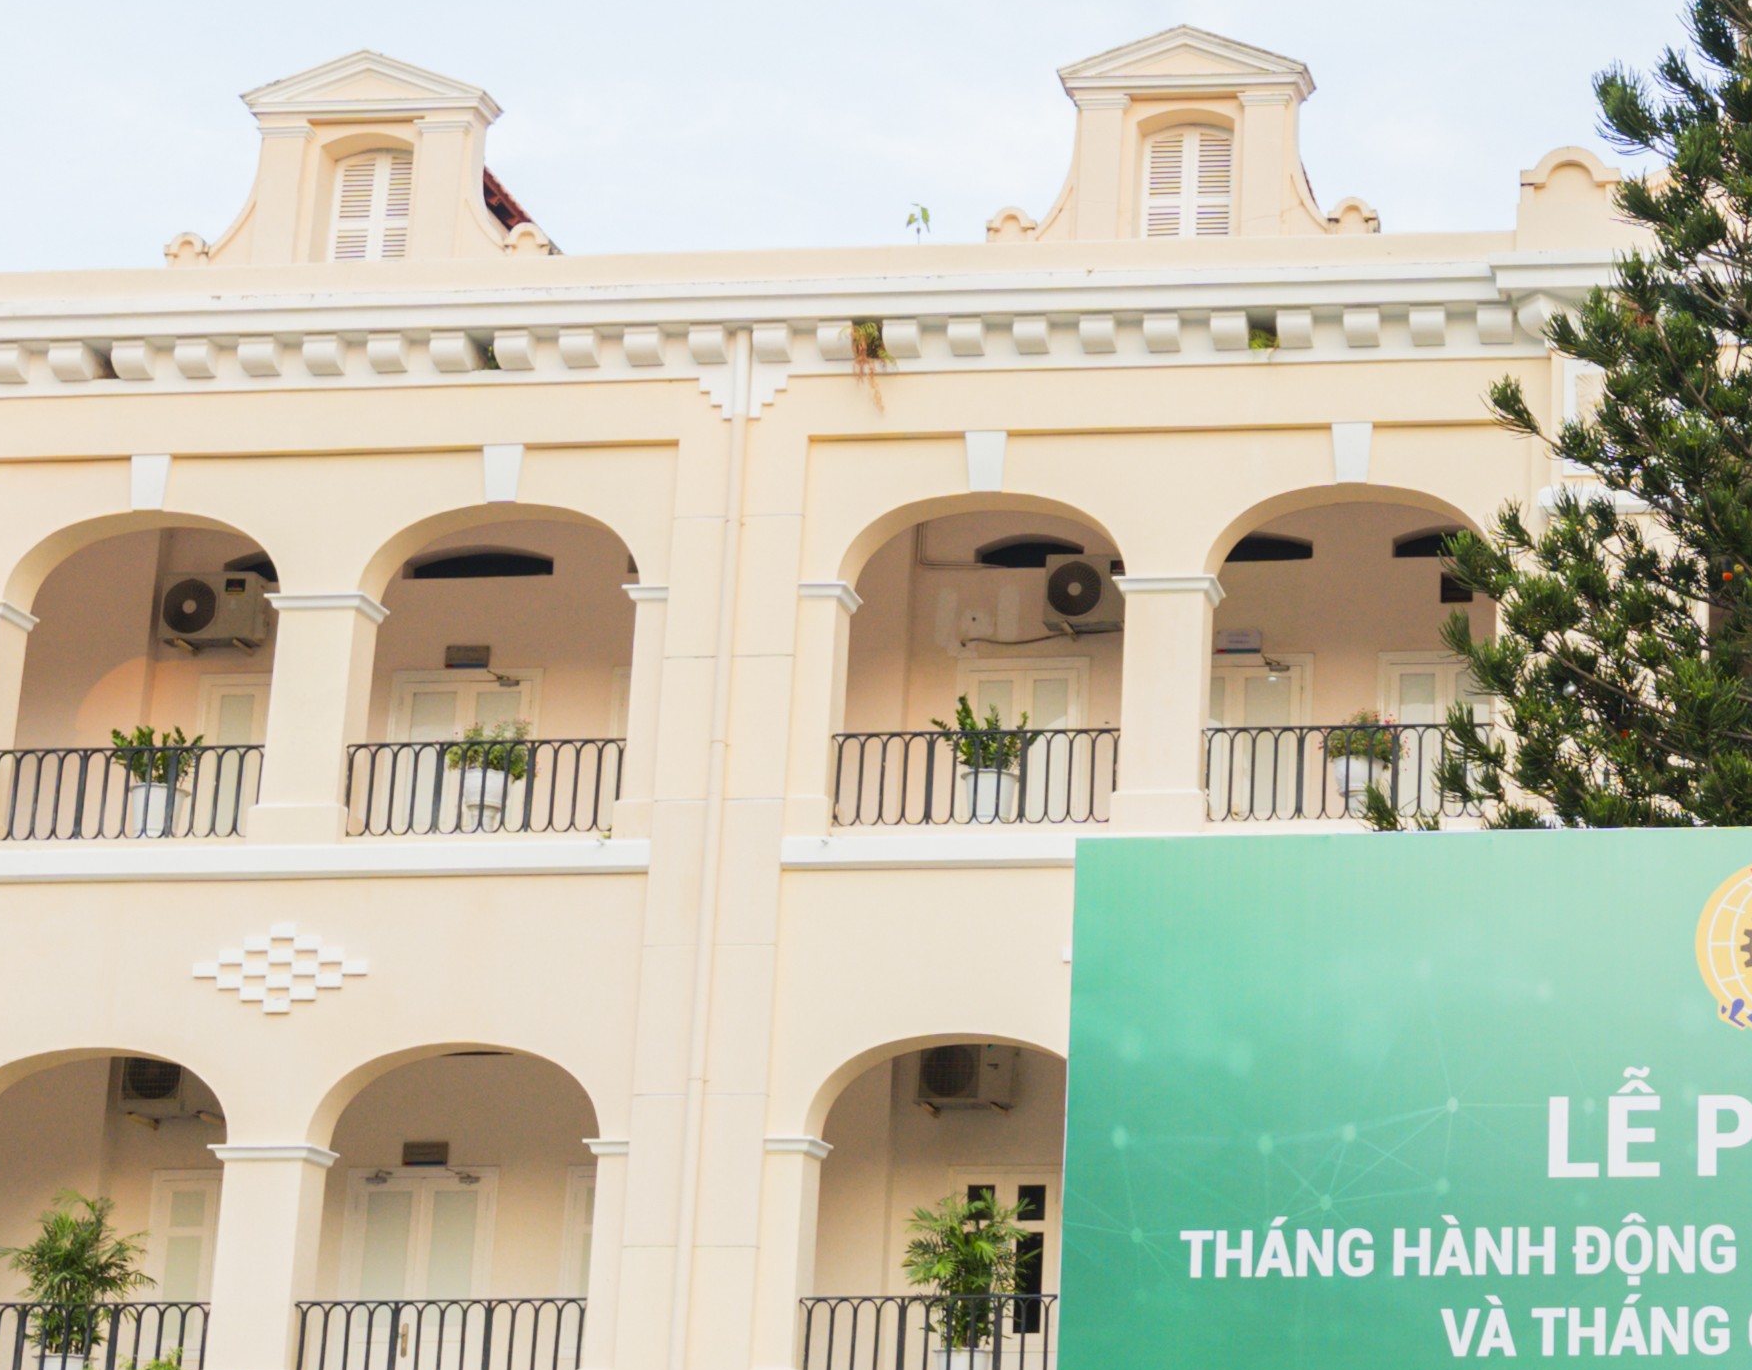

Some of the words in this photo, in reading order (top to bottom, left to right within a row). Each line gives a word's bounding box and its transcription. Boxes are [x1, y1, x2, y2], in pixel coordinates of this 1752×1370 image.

[1548, 1067, 1661, 1178] LỄ
[1180, 1216, 1374, 1278] THÁNG
[1392, 1214, 1556, 1277] HÀNH
[1572, 1212, 1737, 1287] ĐỘNG
[1440, 1295, 1516, 1357] VÀ
[1531, 1296, 1731, 1356] THÁNG
